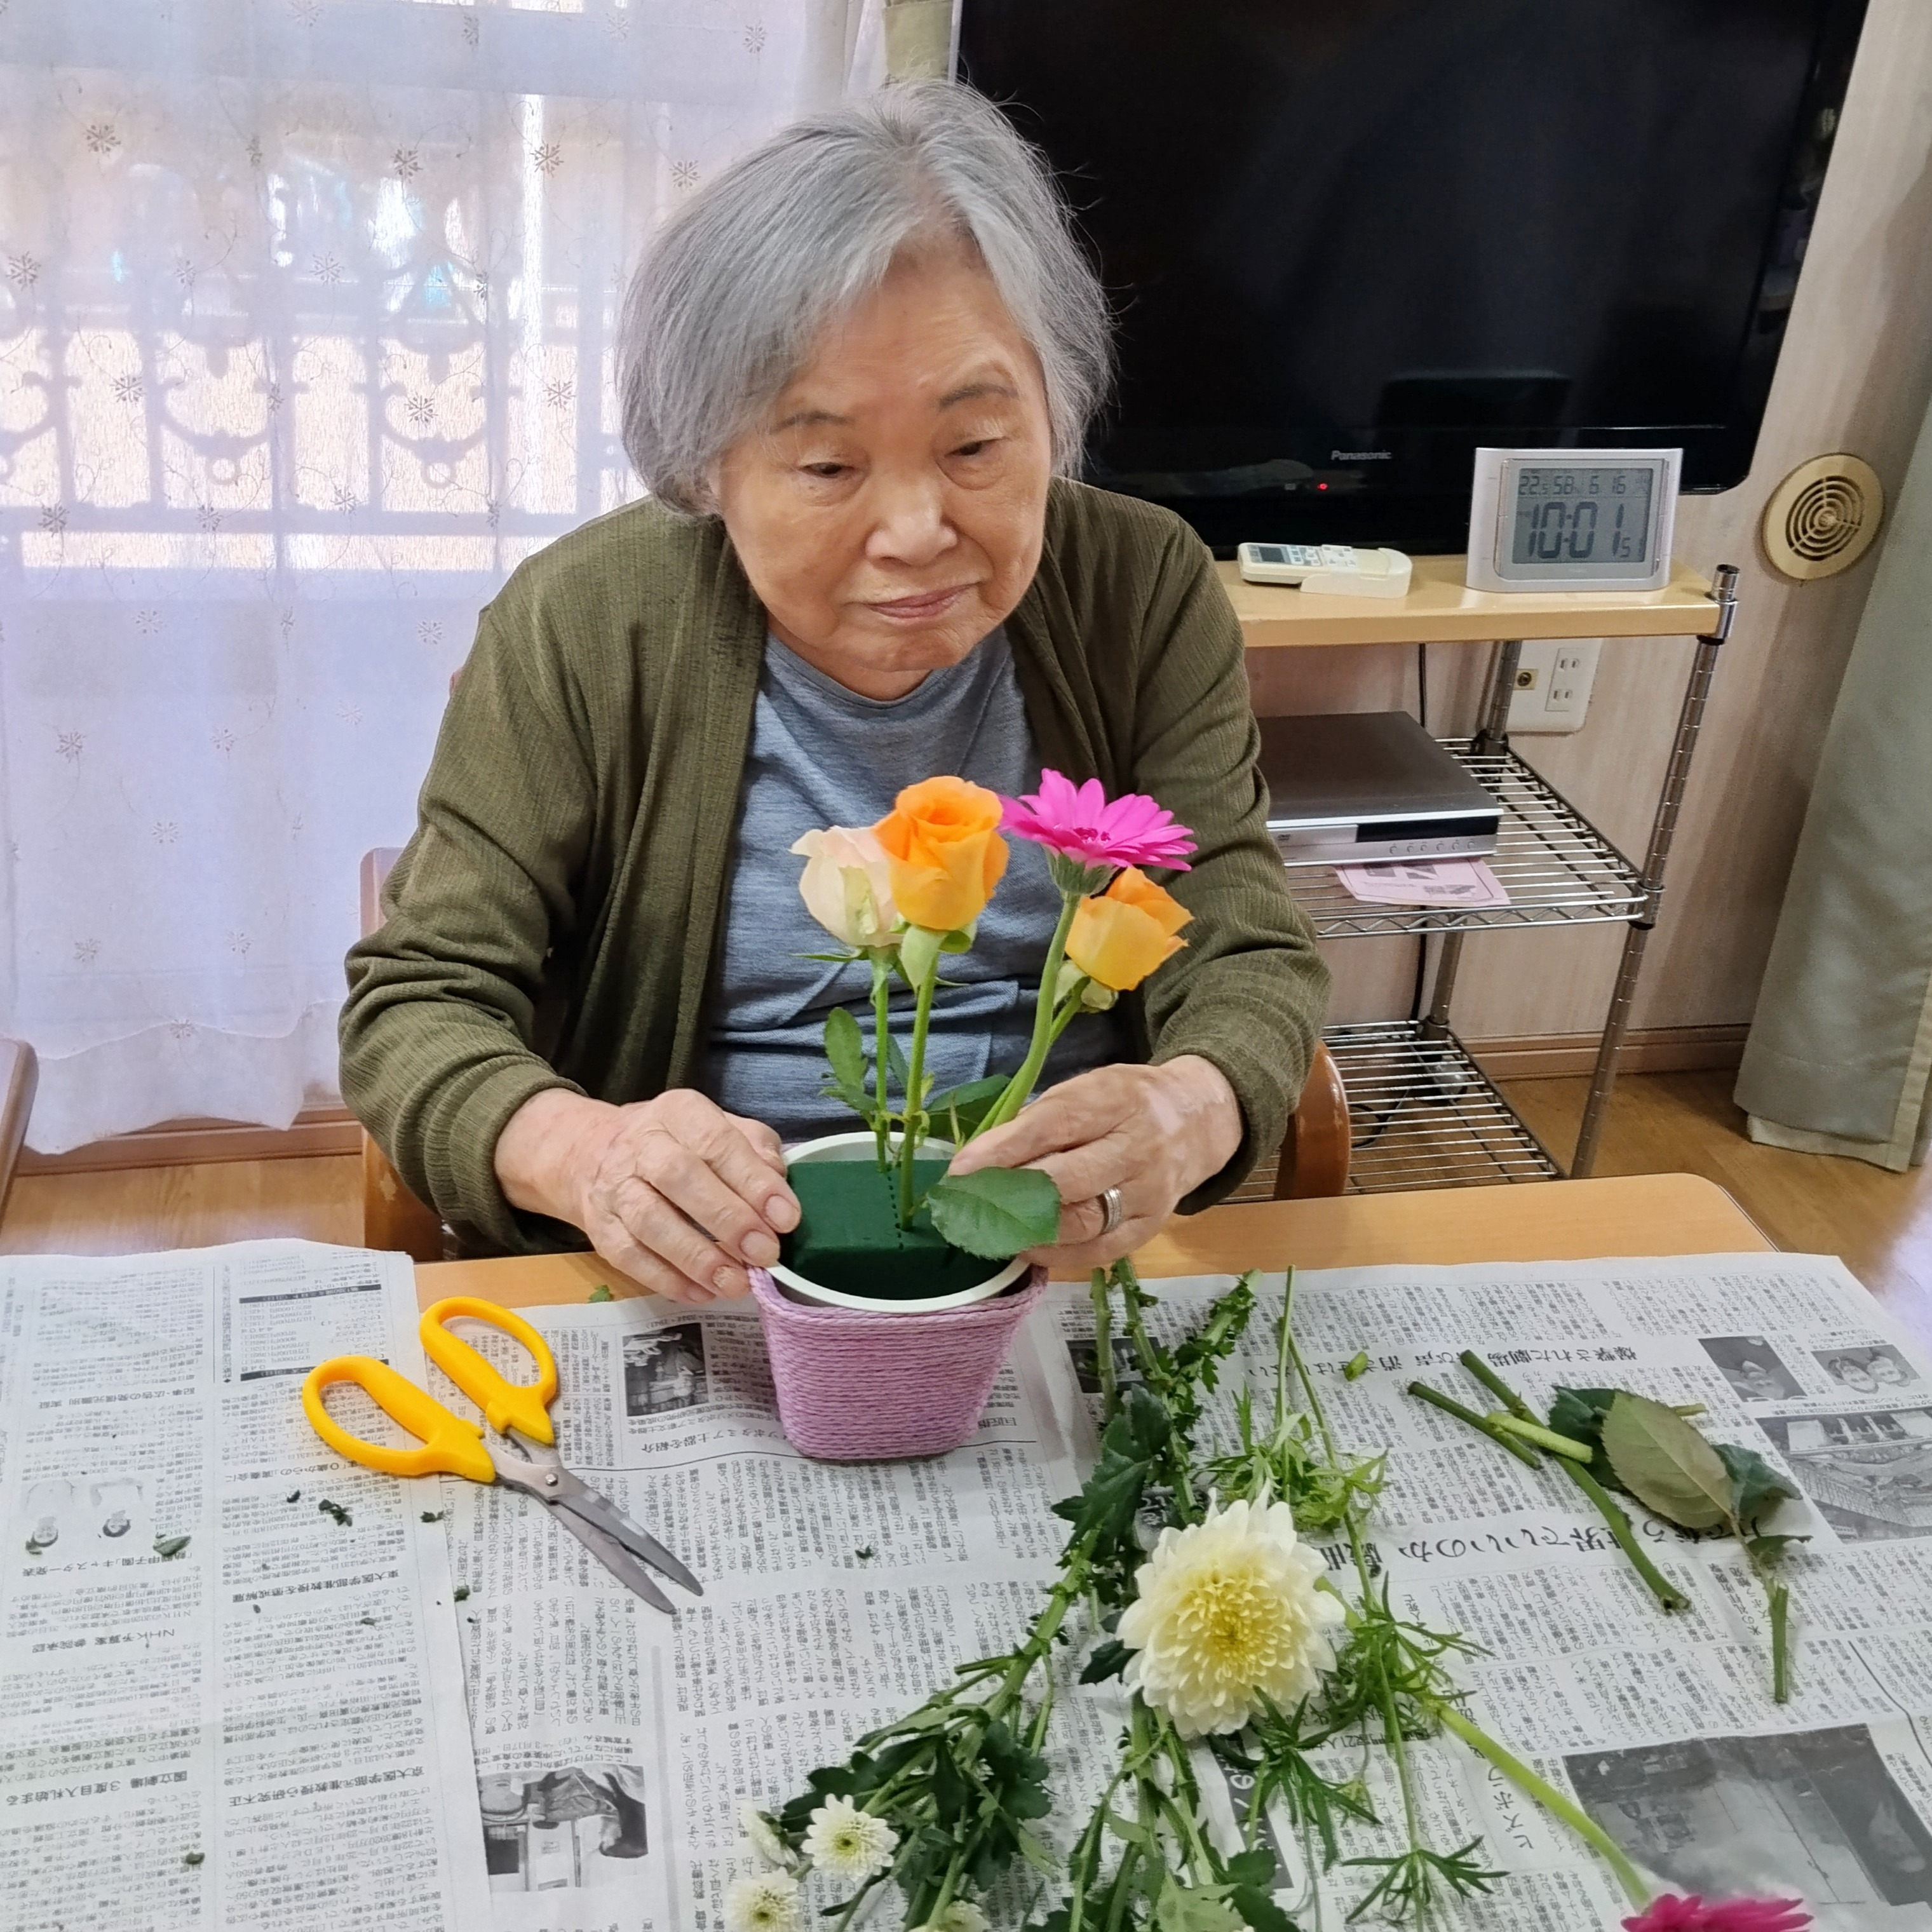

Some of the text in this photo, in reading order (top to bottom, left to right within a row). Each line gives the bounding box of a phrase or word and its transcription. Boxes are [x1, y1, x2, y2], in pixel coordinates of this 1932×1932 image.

[1331, 450, 1392, 461] Panasonic
[1529, 501, 1625, 559] 10:01
[1486, 1346, 1637, 1368] 爆撃された劇場
[37, 1387, 196, 1409] 記事・広告の発信元識別 実証
[1397, 1514, 1766, 1564] でう世界でいいのか
[231, 1570, 399, 1604] 東大医学部准教授を懲戒解雇
[1706, 1562, 1762, 1637] 米の礼拝所襲撃
[32, 1628, 175, 1654] NHK予算案 参院承認
[859, 1656, 877, 1698] ところです。
[4, 1770, 187, 1807] 国立劇場 ３度目入札始まる
[228, 1766, 424, 1807] 京大医学部元准教授ら研究不正
